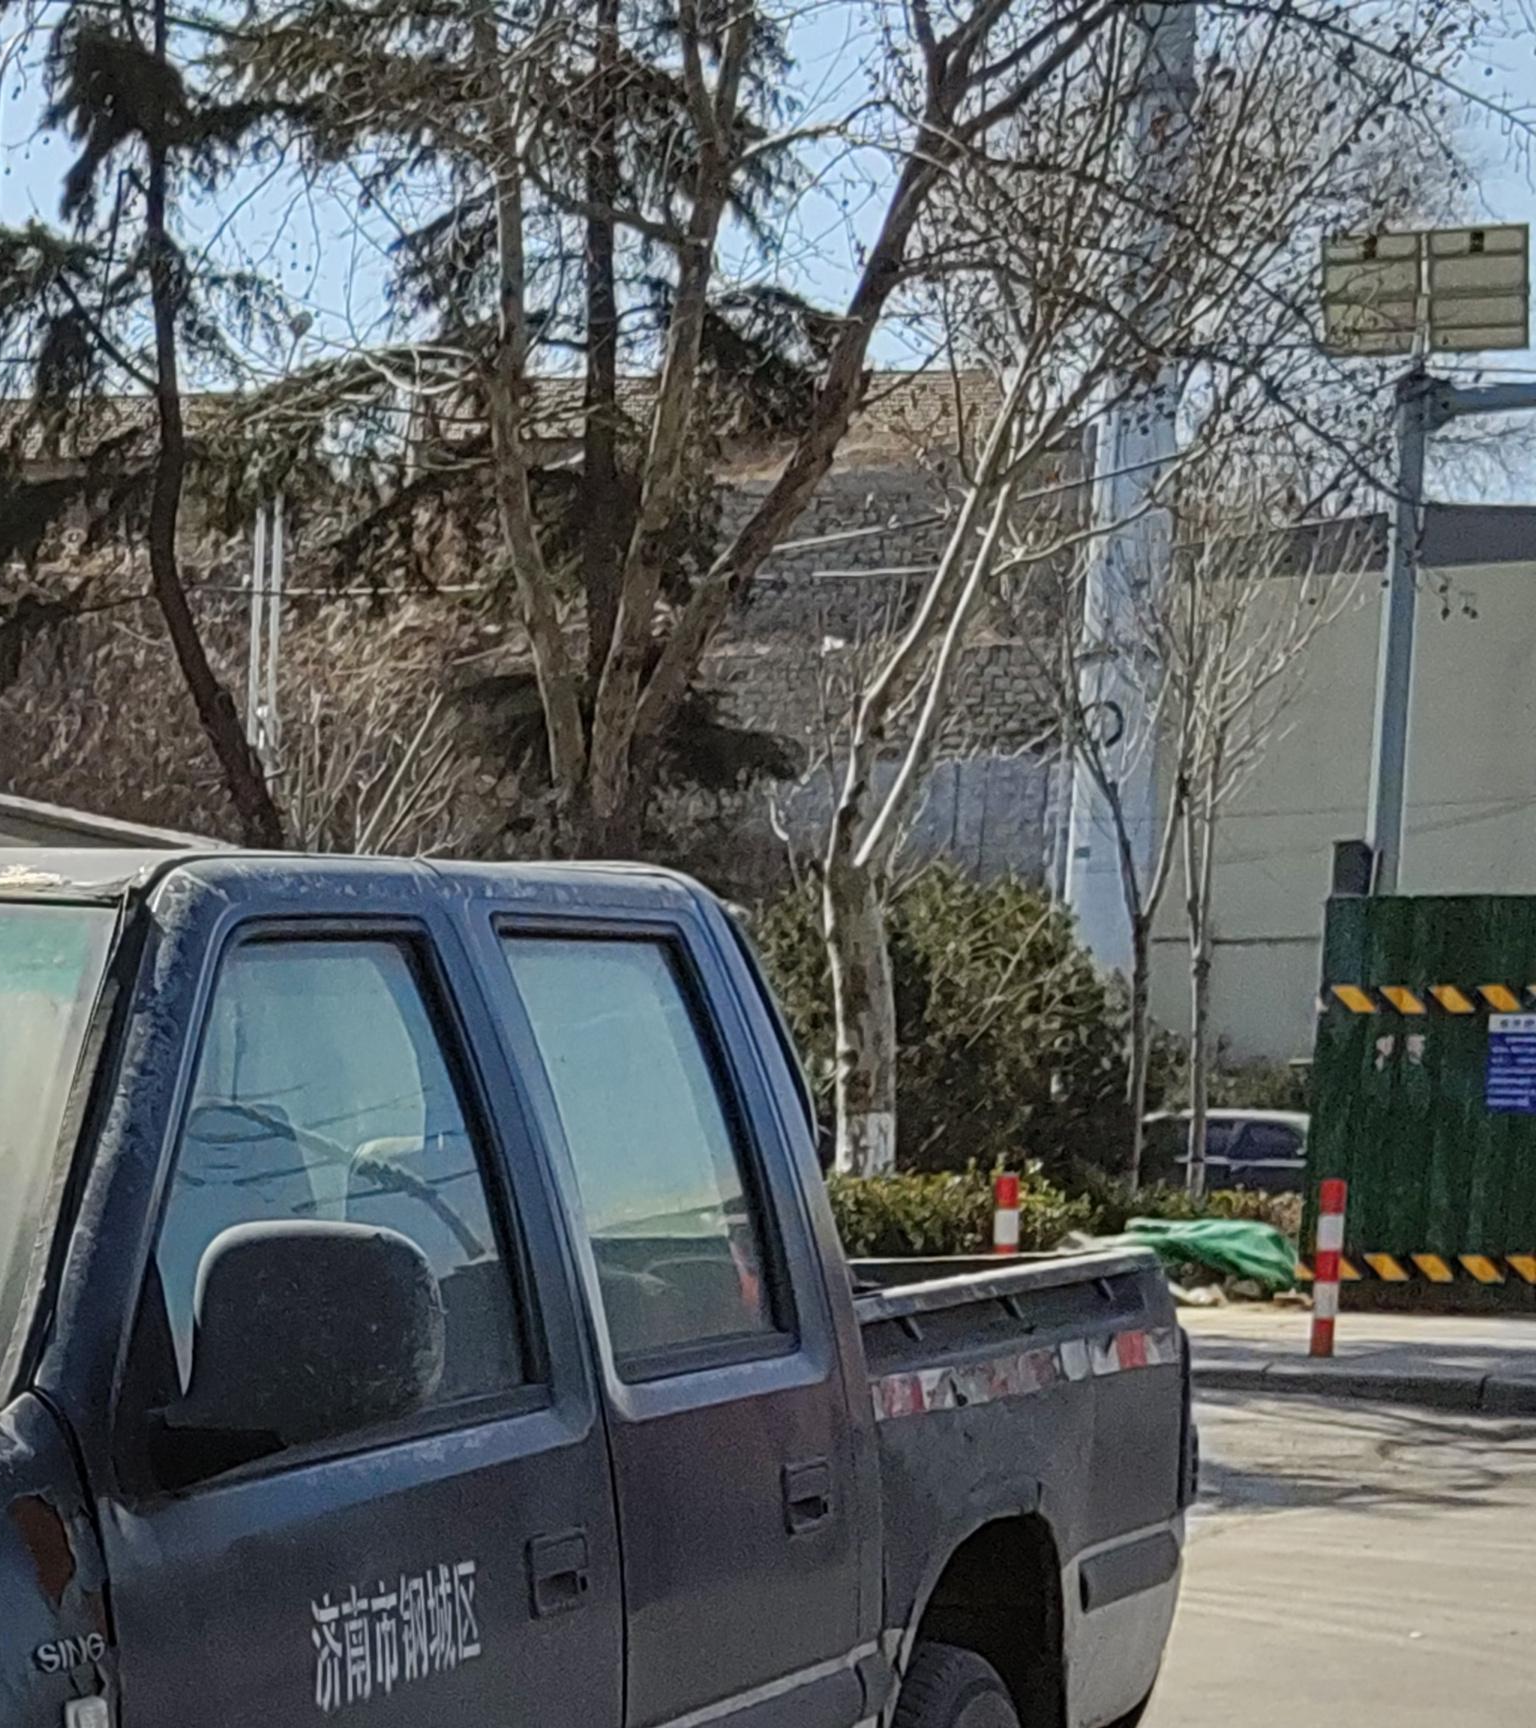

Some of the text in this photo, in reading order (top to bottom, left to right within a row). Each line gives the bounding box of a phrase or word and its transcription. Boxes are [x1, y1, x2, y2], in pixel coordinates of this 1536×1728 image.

[35, 1631, 106, 1674] SING
[311, 1560, 481, 1711] 济南市钢城区
